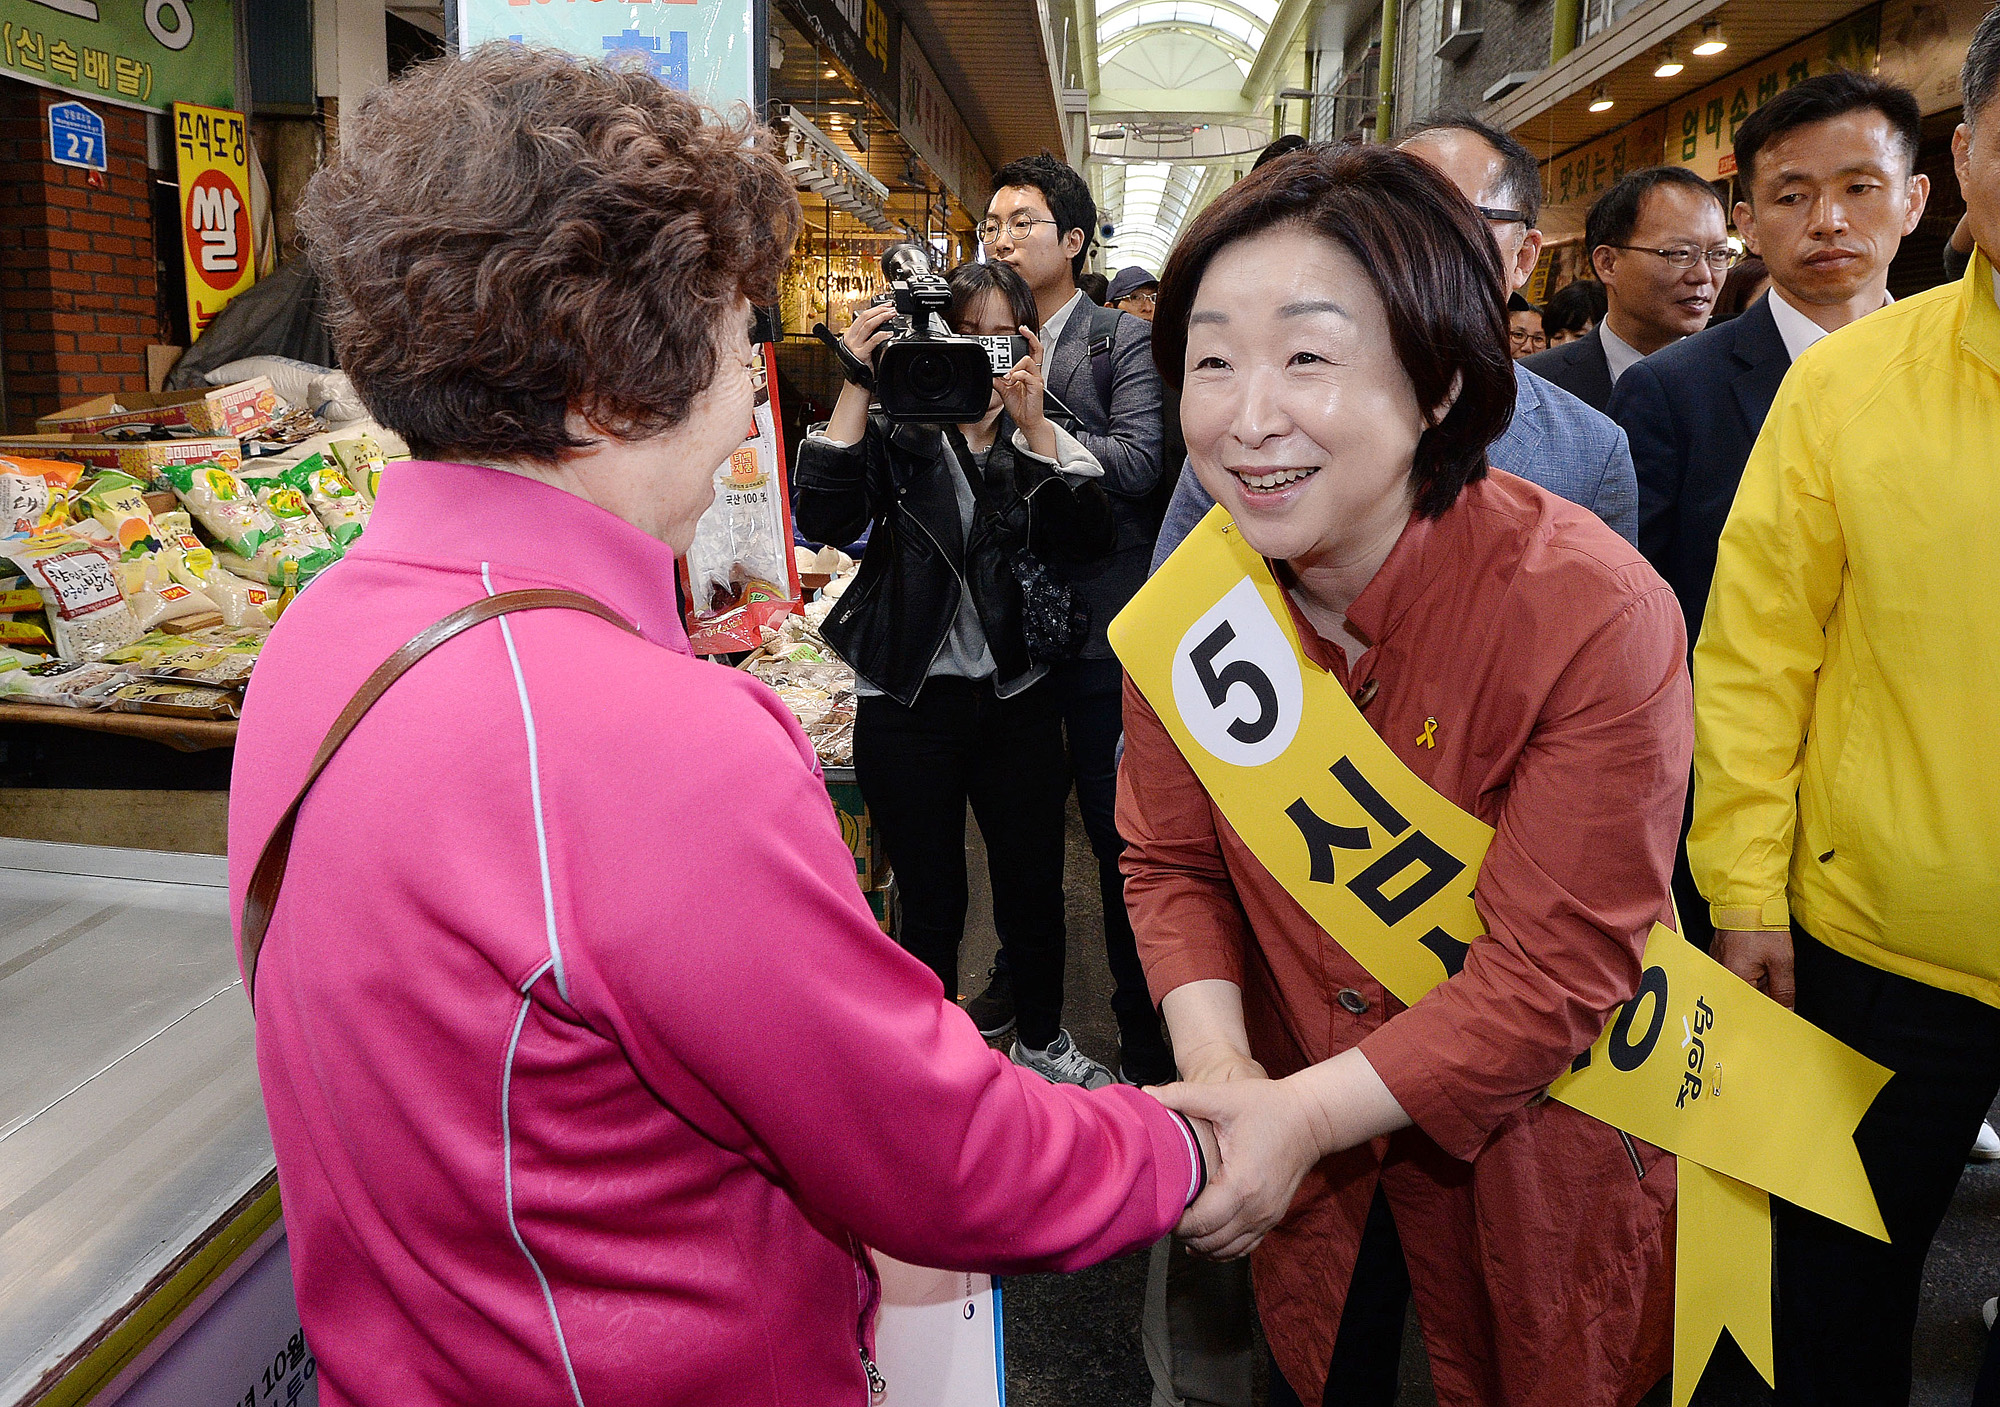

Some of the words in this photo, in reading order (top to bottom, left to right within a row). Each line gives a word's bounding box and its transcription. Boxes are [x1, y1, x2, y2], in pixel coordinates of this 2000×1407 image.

[3, 21, 153, 102] (신속배달)
[66, 132, 95, 161] 27
[178, 111, 246, 168] 즉석도정
[191, 185, 241, 272] 쌀
[726, 494, 740, 507] 국산
[743, 492, 757, 504] 100
[1188, 619, 1280, 745] 5
[1674, 995, 1716, 1111] 정의당
